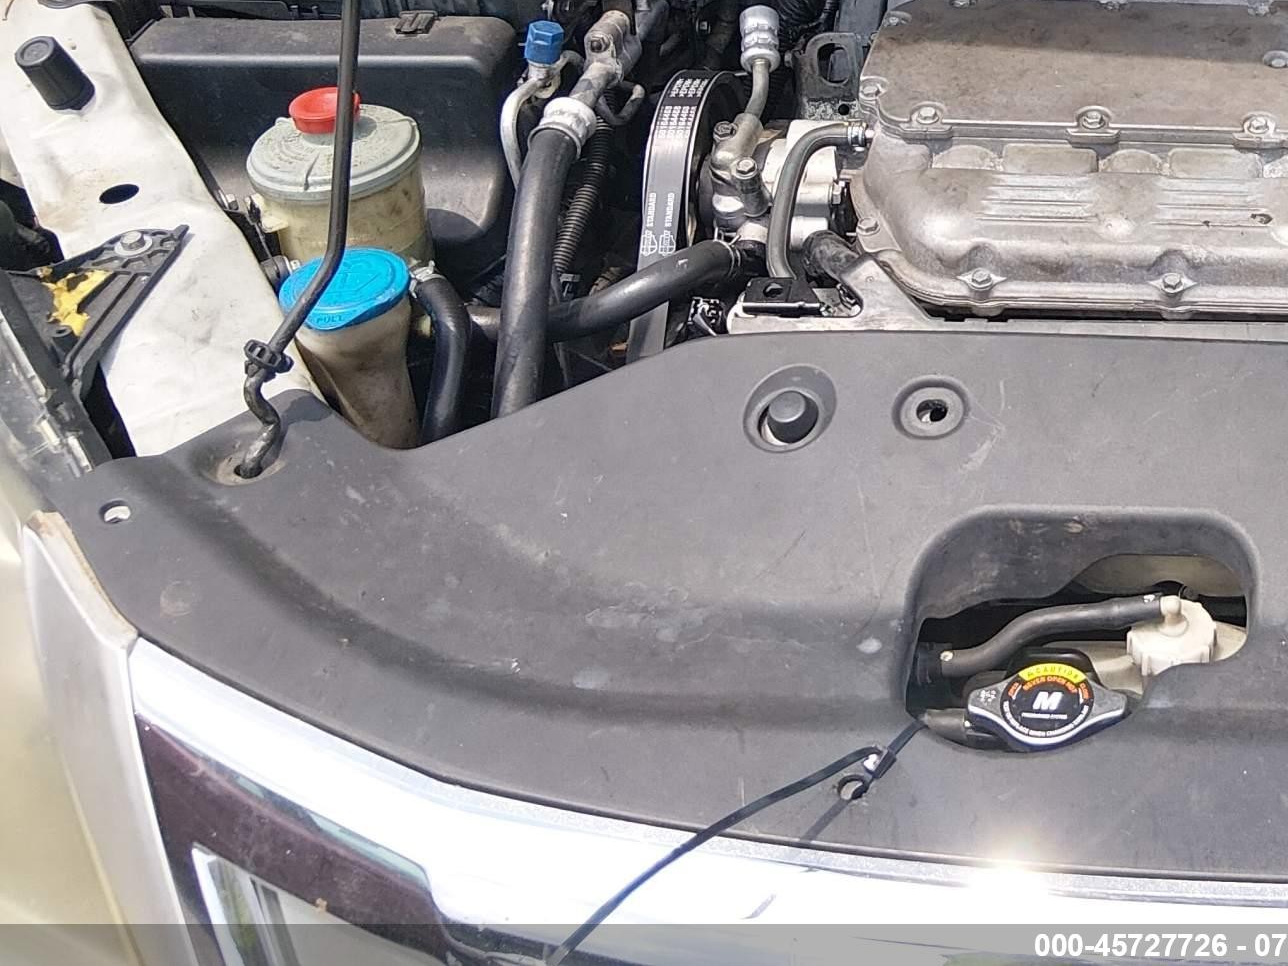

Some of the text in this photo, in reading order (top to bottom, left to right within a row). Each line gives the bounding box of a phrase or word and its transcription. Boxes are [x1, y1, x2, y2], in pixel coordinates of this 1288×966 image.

[646, 192, 657, 227] STANDARD
[316, 315, 344, 324] PULL
[1035, 666, 1079, 679] CAUTION
